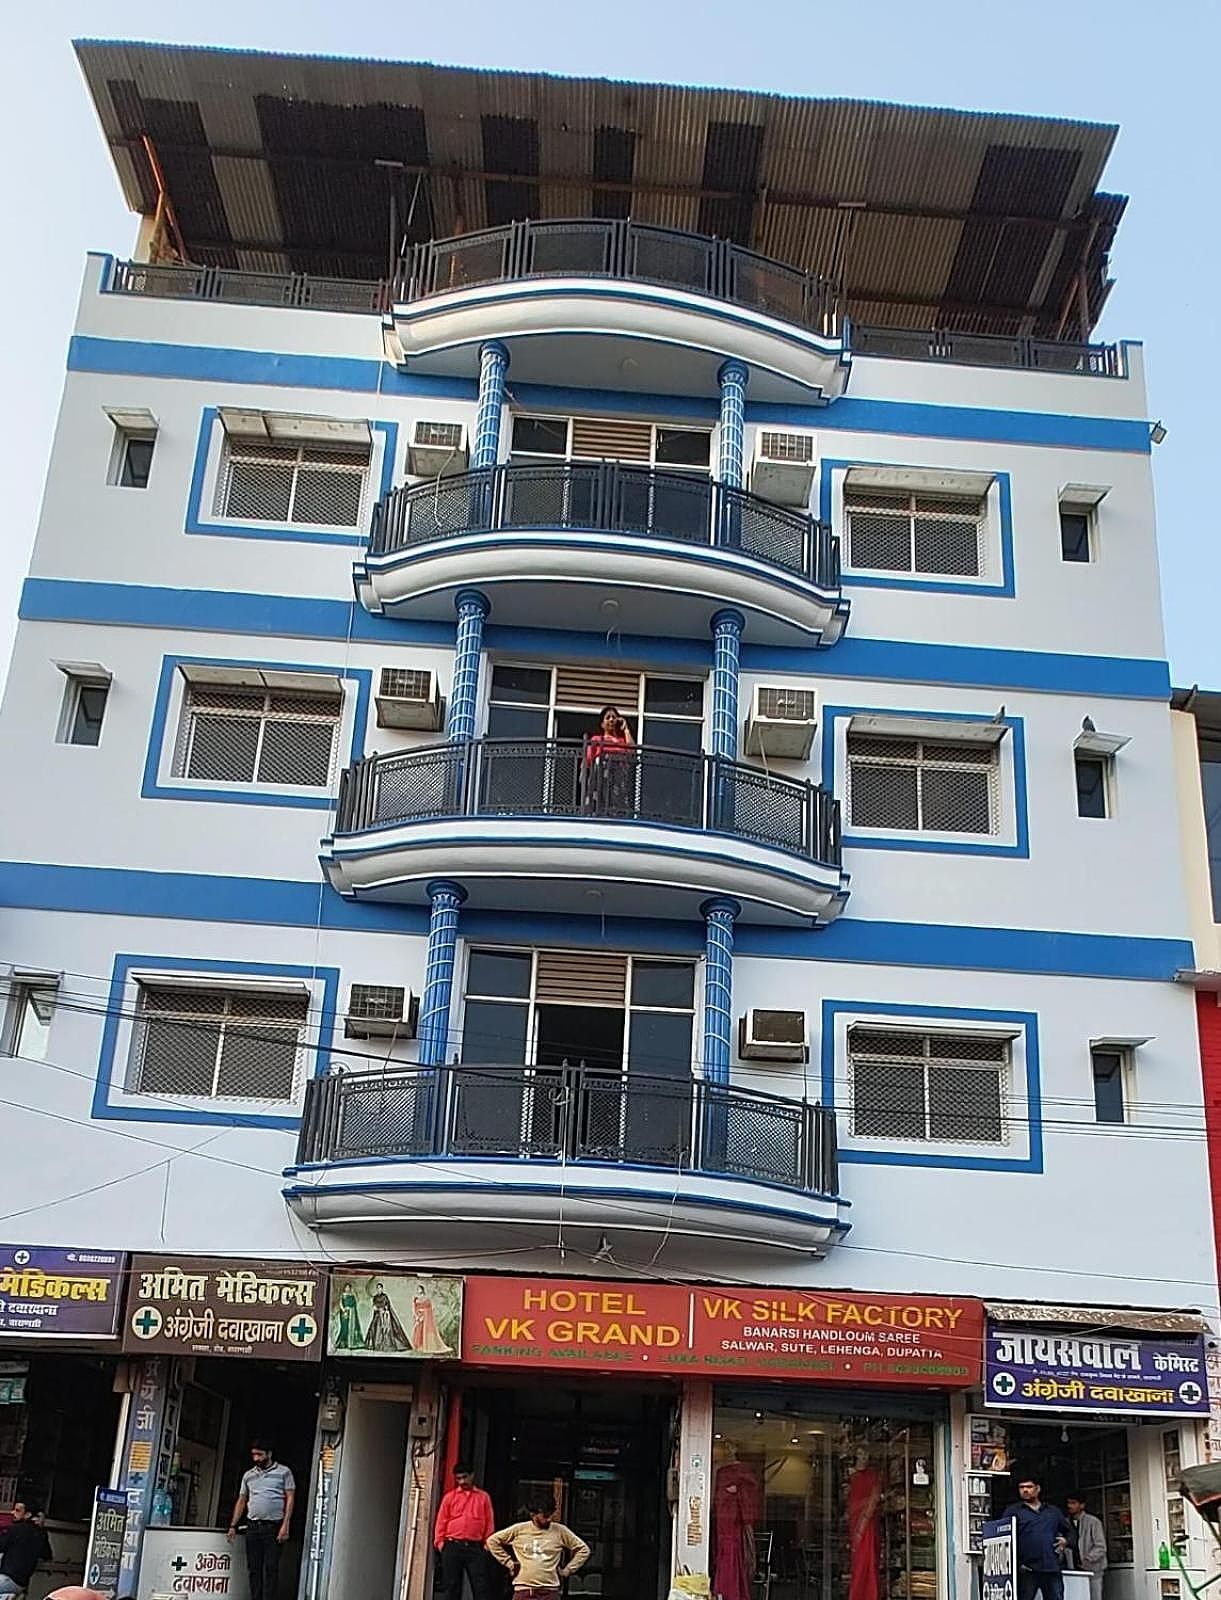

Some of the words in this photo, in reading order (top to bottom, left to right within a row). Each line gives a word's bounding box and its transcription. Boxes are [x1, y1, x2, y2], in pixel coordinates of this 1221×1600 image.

[138, 1266, 209, 1301] अमित
[215, 1270, 317, 1306] मेडिकल्स
[523, 1288, 647, 1316] HOTEL
[703, 1297, 743, 1320] VK
[751, 1299, 816, 1323] SILK
[826, 1303, 964, 1330] FACTORY
[163, 1307, 215, 1342] अंग्रेजी
[217, 1318, 285, 1343] दवाखाना
[484, 1317, 537, 1341] VK
[546, 1320, 681, 1347] GRAND
[743, 1326, 801, 1340] BANARSI
[878, 1331, 921, 1345] SAREE
[721, 1339, 778, 1353] SALWAR,
[780, 1342, 818, 1355] SUTE,
[820, 1344, 884, 1358] LEHENGA,
[1153, 1352, 1200, 1373] केमिस्ट
[1021, 1378, 1086, 1401] अंग्रेजी
[1089, 1386, 1175, 1403] दवाखाना
